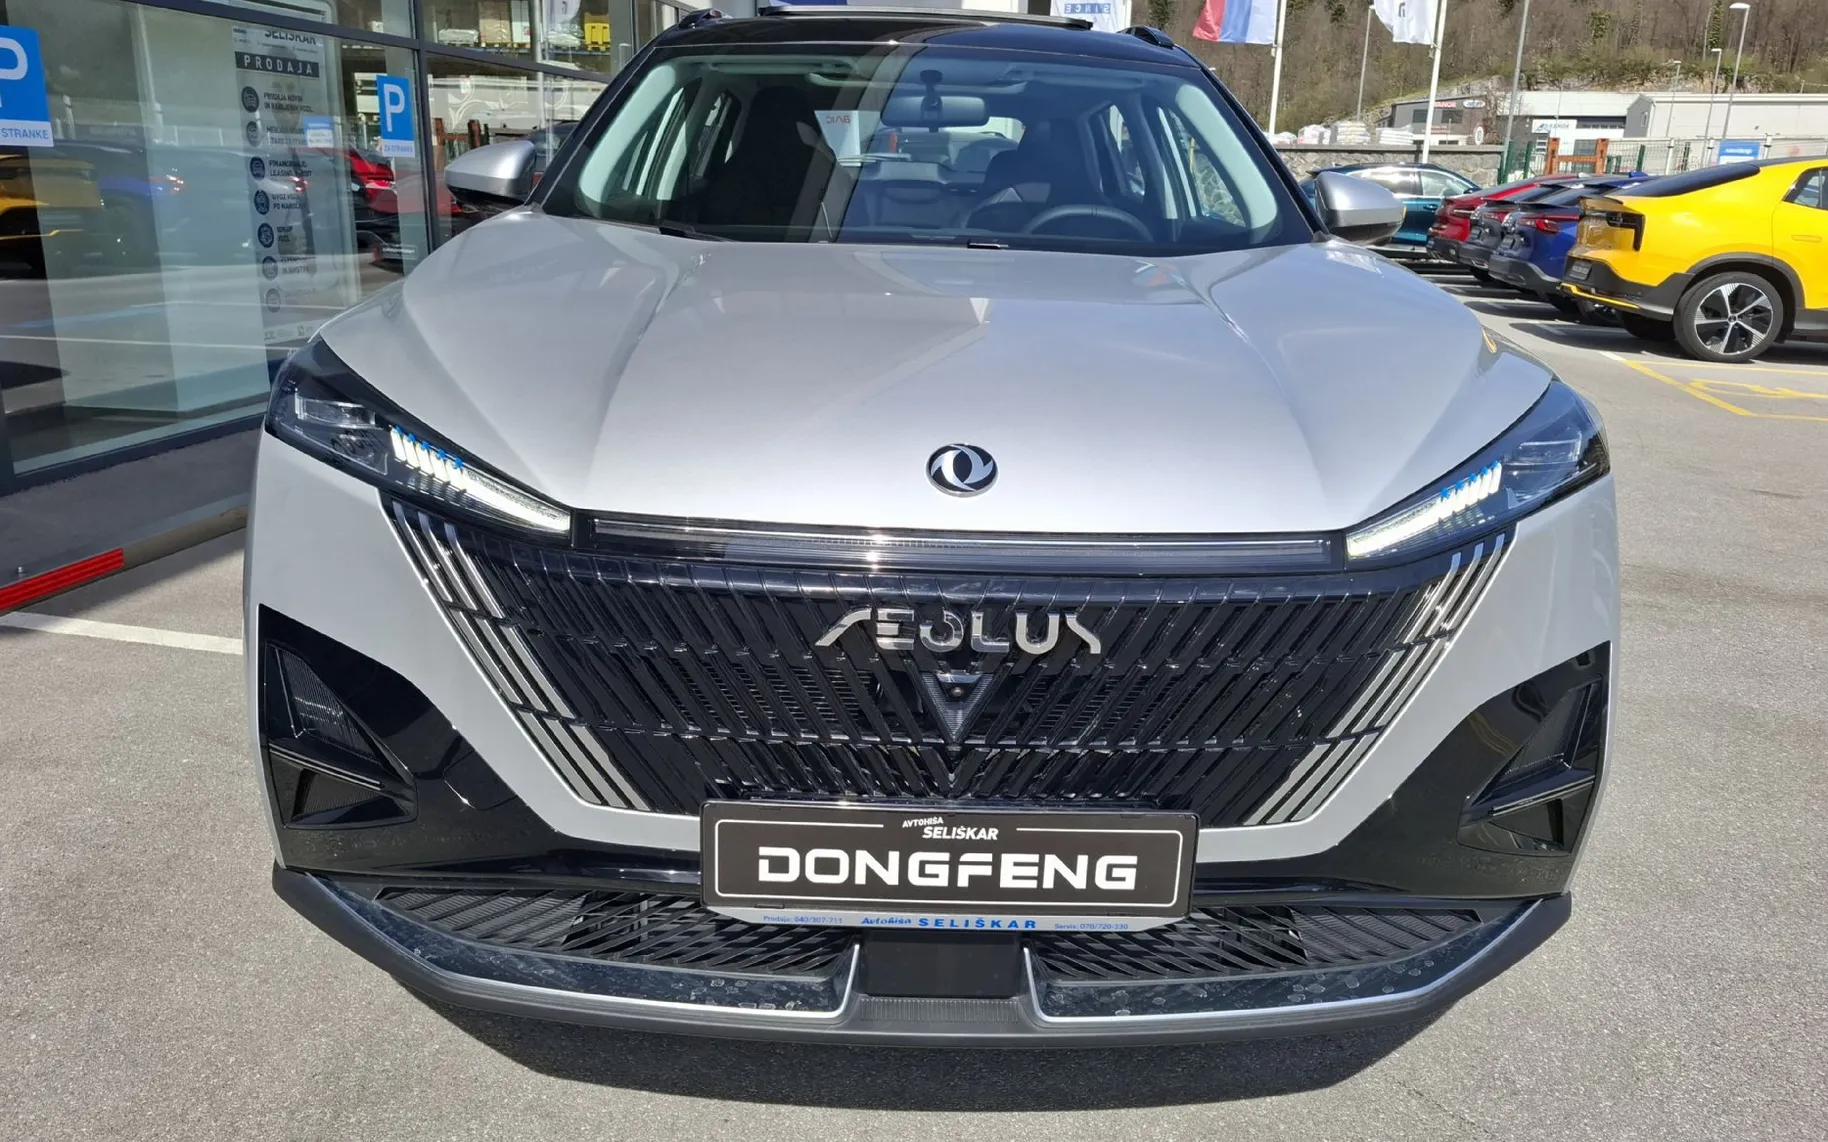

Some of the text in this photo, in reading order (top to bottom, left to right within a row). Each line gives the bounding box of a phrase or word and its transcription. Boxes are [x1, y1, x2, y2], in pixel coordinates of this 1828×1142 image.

[243, 54, 313, 75] PRODAJA
[383, 83, 405, 132] P
[1, 128, 49, 139] STRANKE
[922, 826, 999, 840] SELIŠKAR
[758, 846, 1138, 890] DONGFENG
[918, 917, 1036, 929] SELIŠKAR
